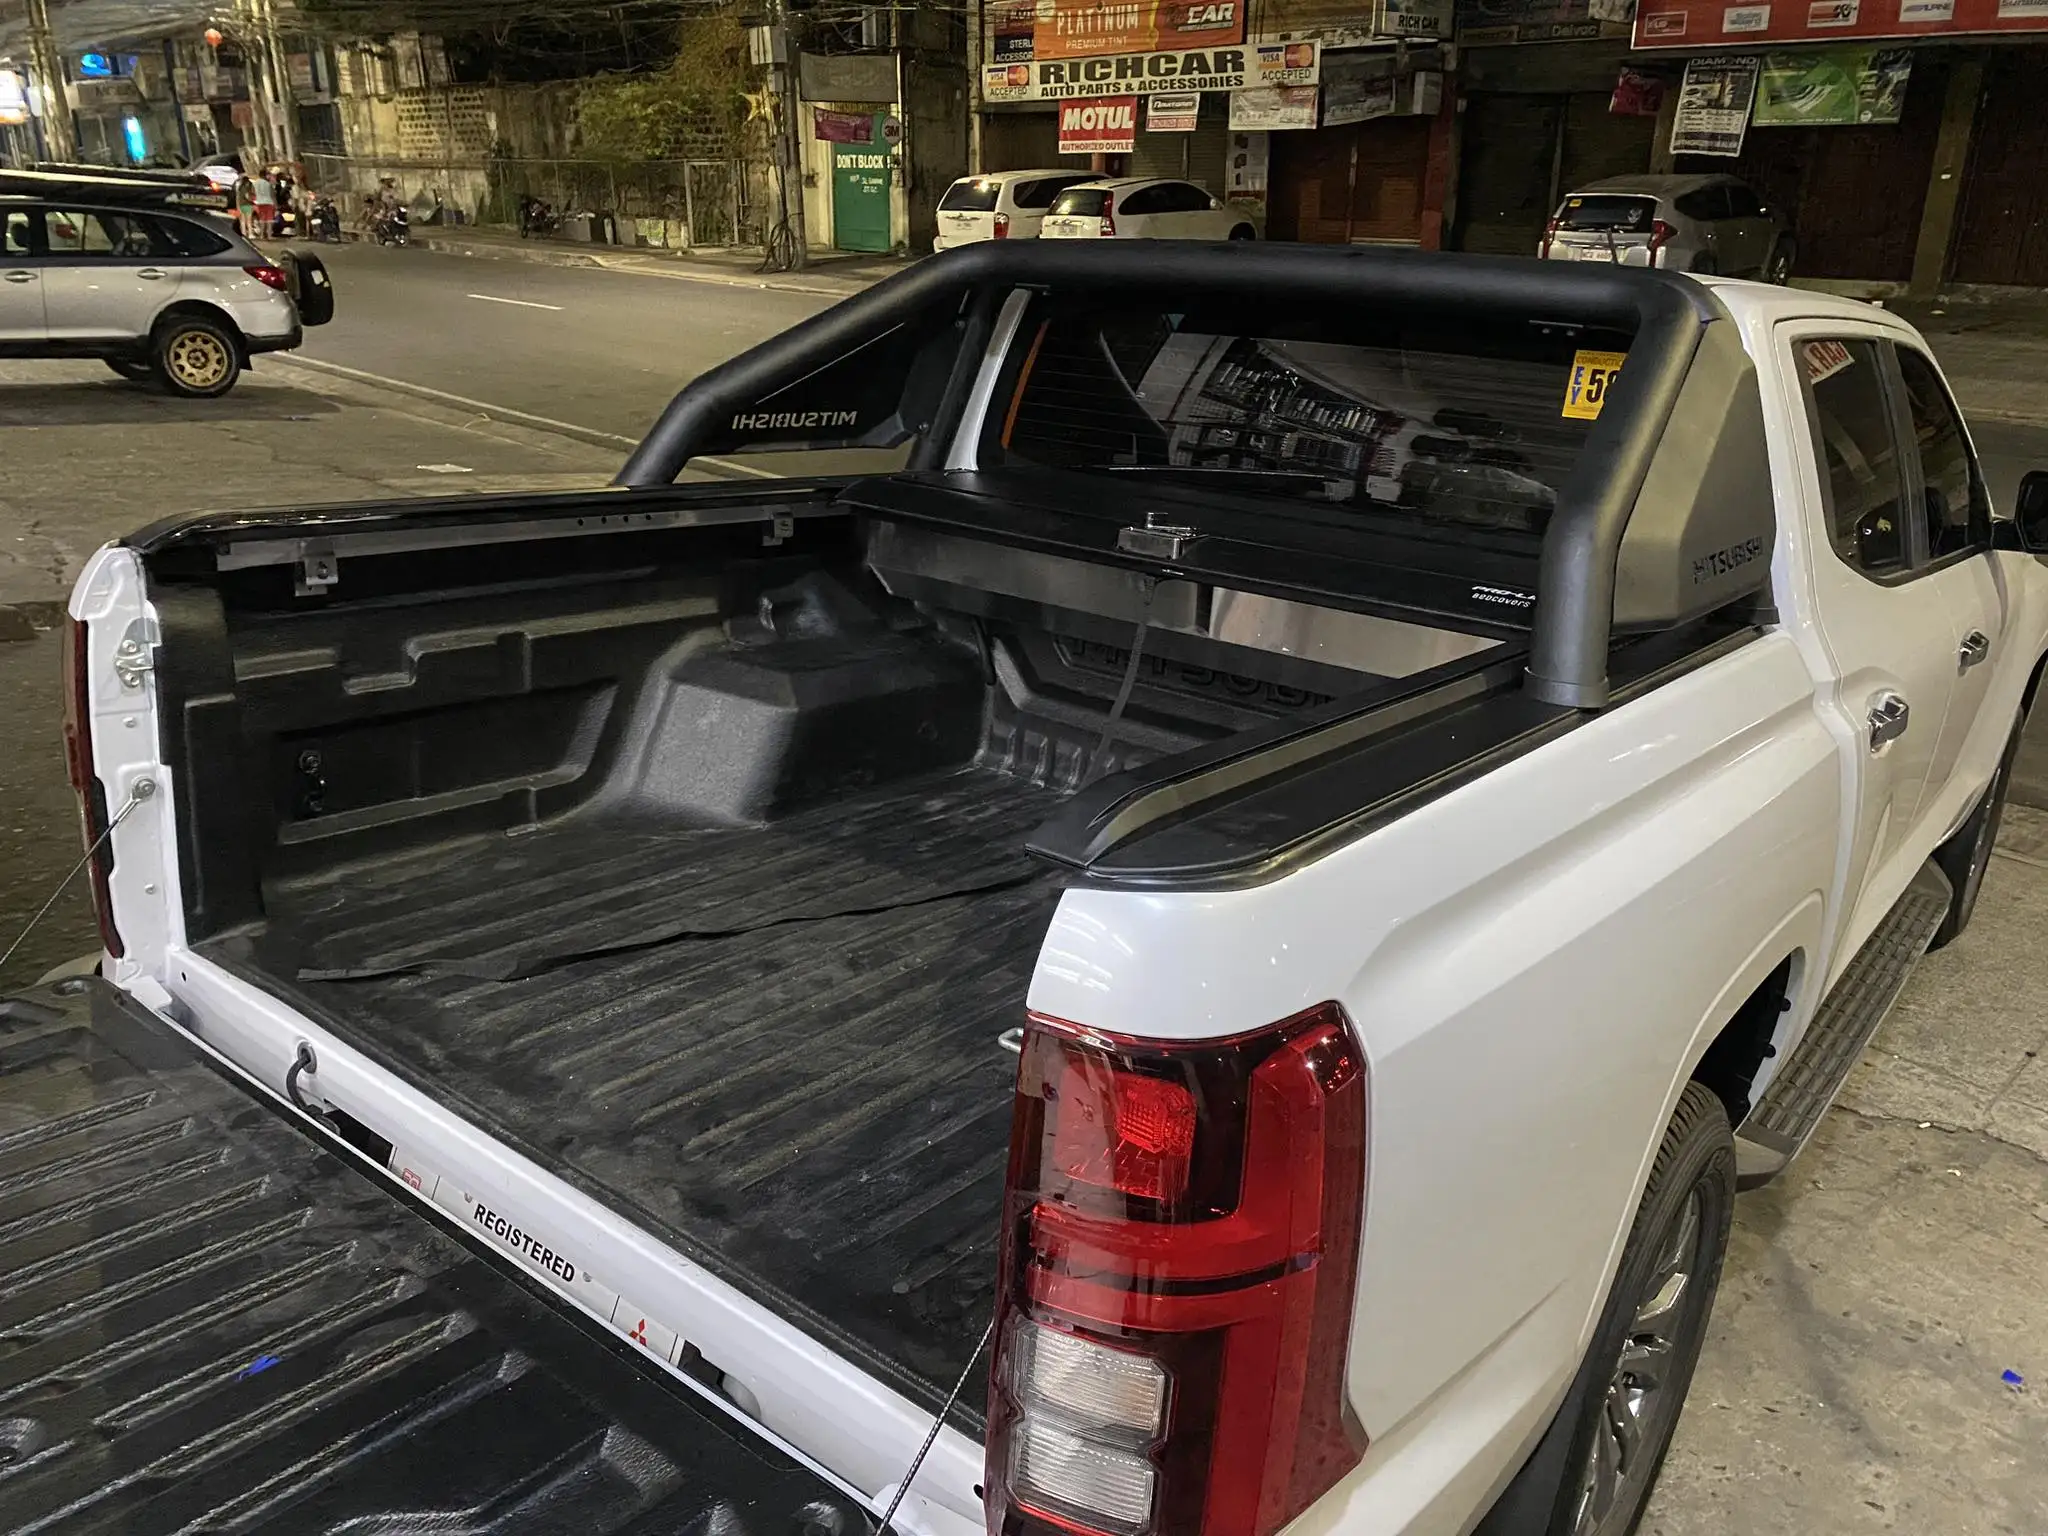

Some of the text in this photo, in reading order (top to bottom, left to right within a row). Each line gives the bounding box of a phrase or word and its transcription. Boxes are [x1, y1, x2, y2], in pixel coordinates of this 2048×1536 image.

[1056, 3, 1139, 36] PLATINUM
[1398, 15, 1420, 28] RICH
[1065, 35, 1128, 50] PREMIUM TINT
[1262, 53, 1280, 62] VISA
[1040, 50, 1245, 84] RICHCAR
[1261, 68, 1311, 80] ACCEPTED
[989, 86, 1028, 97] ACCEPTED
[1041, 74, 1244, 98] AUTO PARTS & ACCESSORIES
[1062, 106, 1134, 131] MOTUL
[884, 125, 900, 137] 3M
[1060, 142, 1105, 151] AUTHORIZED
[836, 154, 857, 169] DON'T
[858, 154, 884, 169] BLOCK
[473, 1202, 576, 1283] REGISTERED
